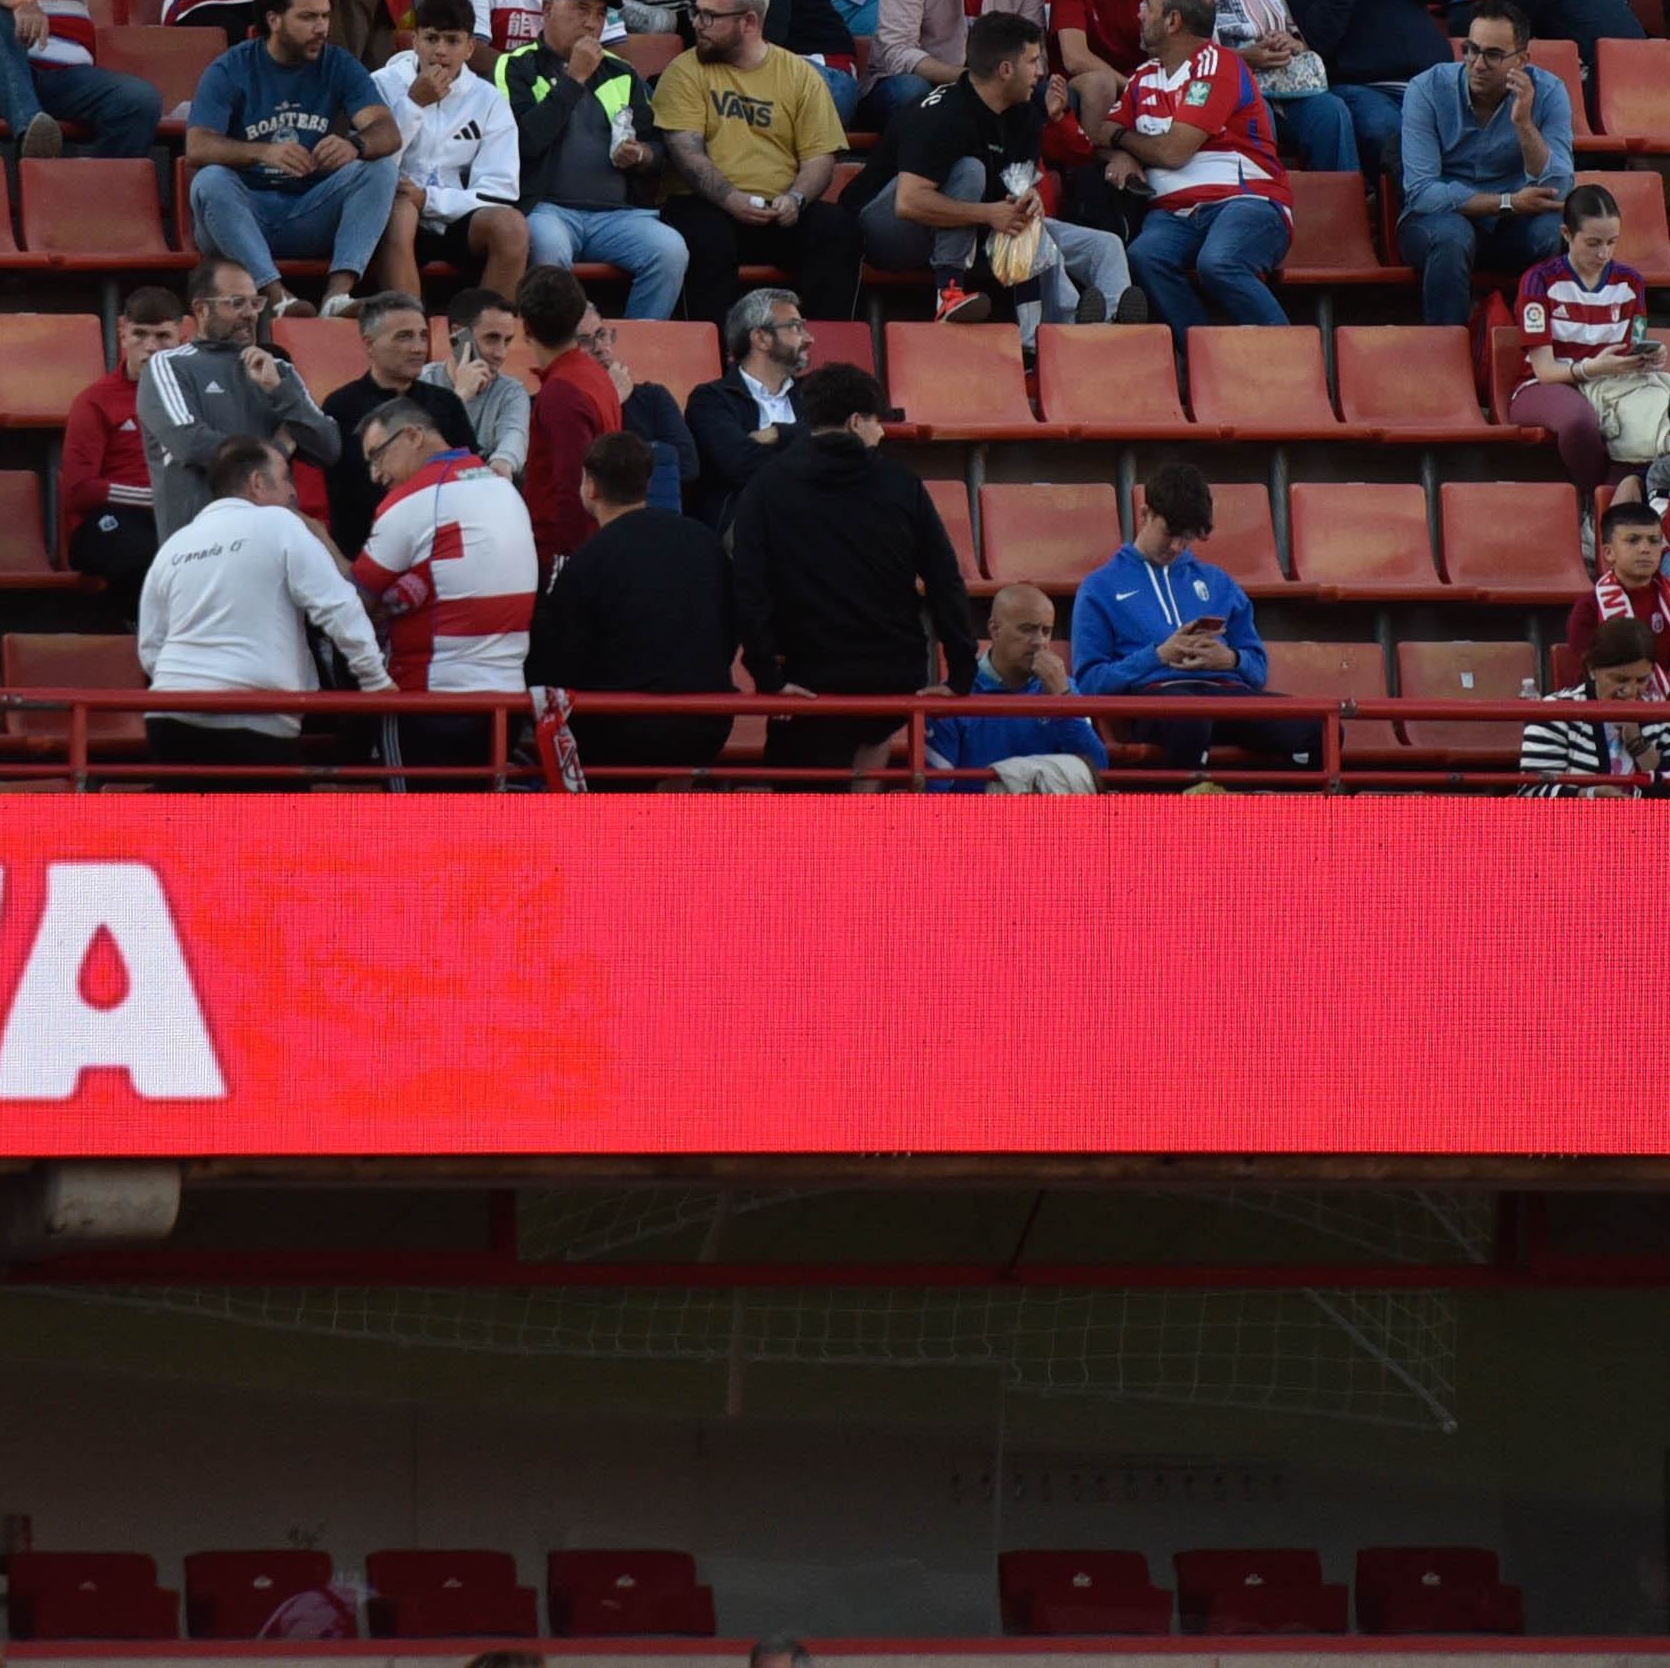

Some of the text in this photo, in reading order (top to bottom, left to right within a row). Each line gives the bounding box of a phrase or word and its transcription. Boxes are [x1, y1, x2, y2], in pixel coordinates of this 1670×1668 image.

[710, 90, 774, 128] VANS
[245, 112, 330, 141] ROASTERS
[172, 542, 223, 566] Granada
